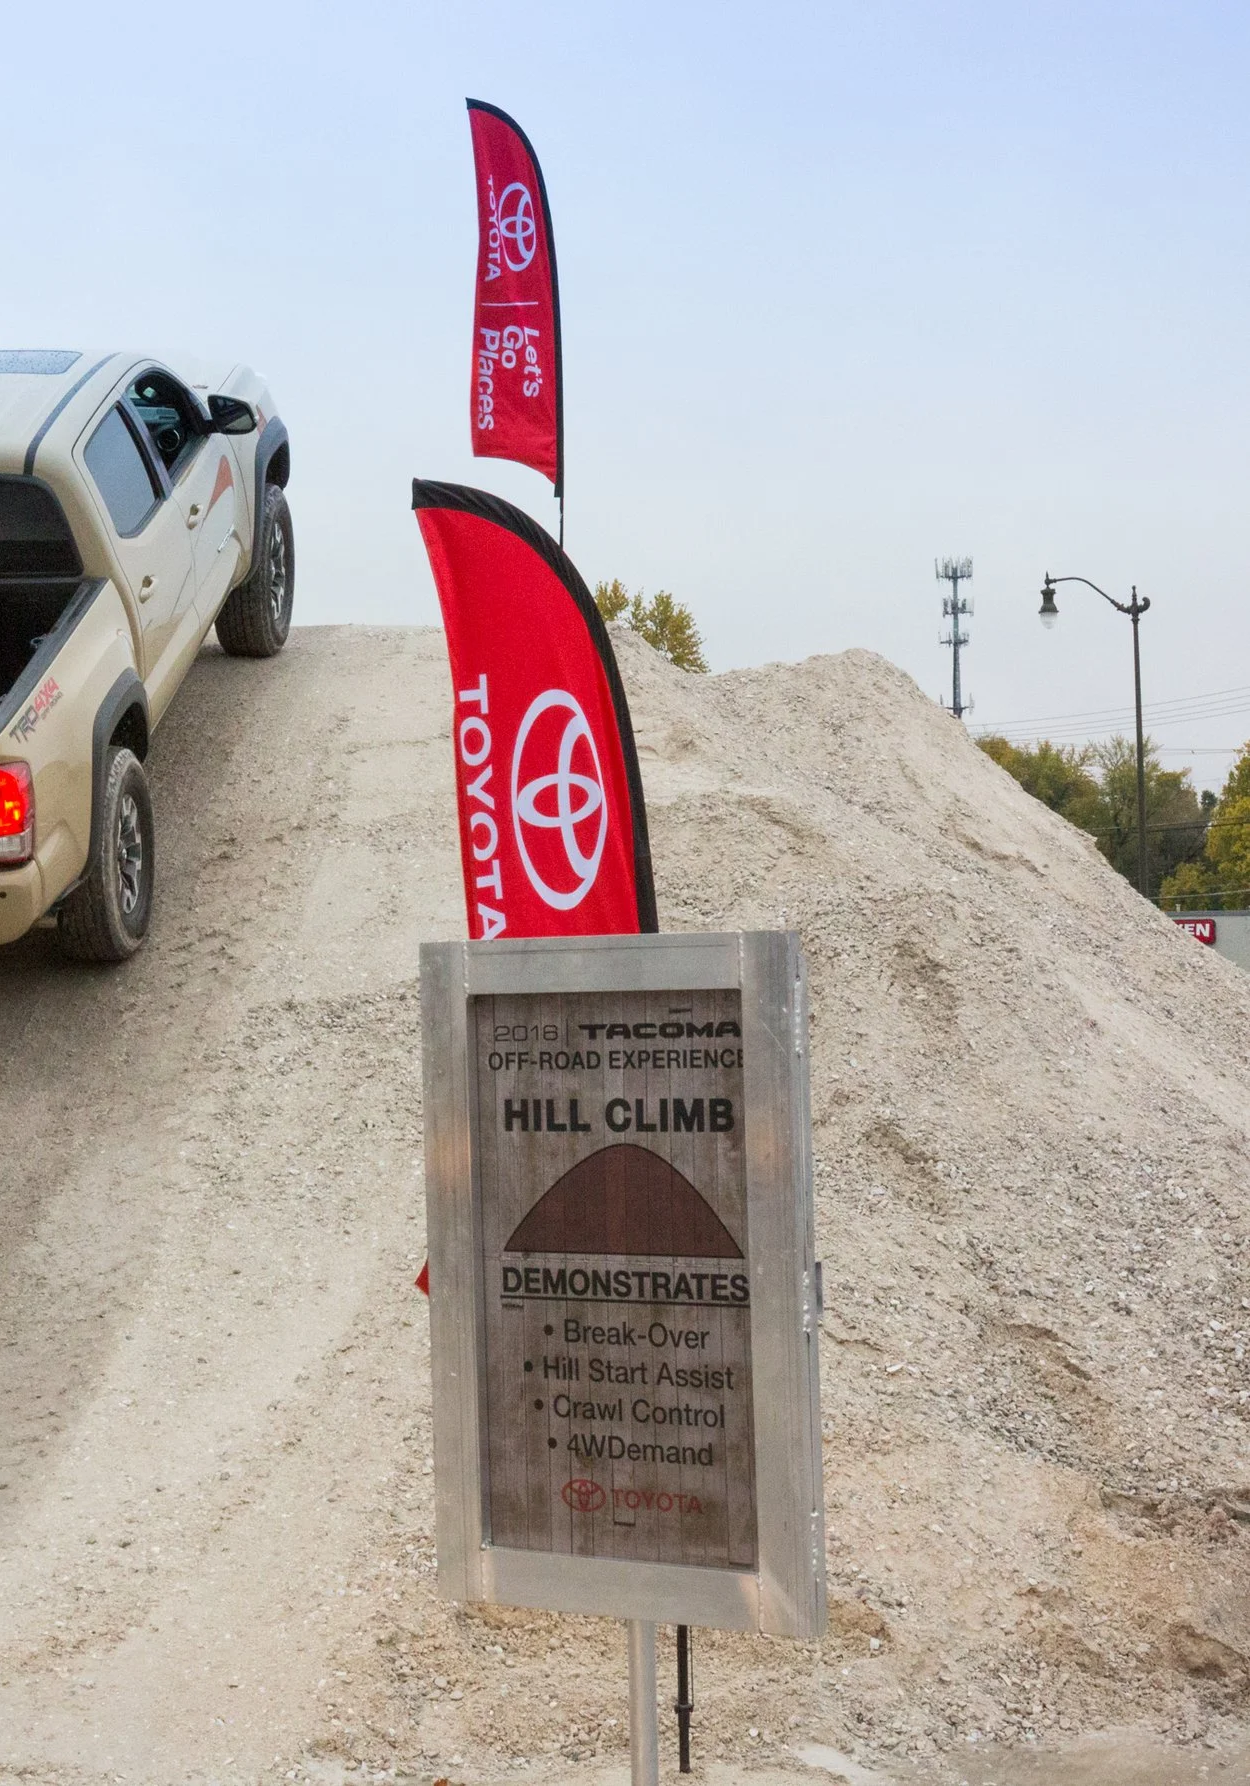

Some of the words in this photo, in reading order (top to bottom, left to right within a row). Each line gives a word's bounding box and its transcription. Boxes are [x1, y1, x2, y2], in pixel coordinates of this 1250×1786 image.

[484, 174, 502, 282] TOYOTA
[501, 325, 523, 368] Go
[522, 325, 543, 398] Let's
[477, 327, 500, 431] Places
[458, 673, 507, 940] TOYOTA
[1179, 923, 1211, 938] EN
[494, 1024, 559, 1042] 2016
[578, 1021, 741, 1040] TACOMA
[488, 1050, 601, 1071] OFF-ROAD
[503, 1099, 592, 1133] HILL
[605, 1097, 736, 1133] CLIMB
[502, 1266, 749, 1303] DEMONSTRATES
[563, 1318, 710, 1350] Break-Over
[543, 1356, 580, 1381] Hill
[589, 1359, 648, 1385] Start
[656, 1362, 735, 1390] Assist
[553, 1394, 622, 1422] Crawl
[631, 1399, 726, 1429] Control
[566, 1433, 714, 1467] 4WDemand
[610, 1488, 704, 1515] TOYOTA
